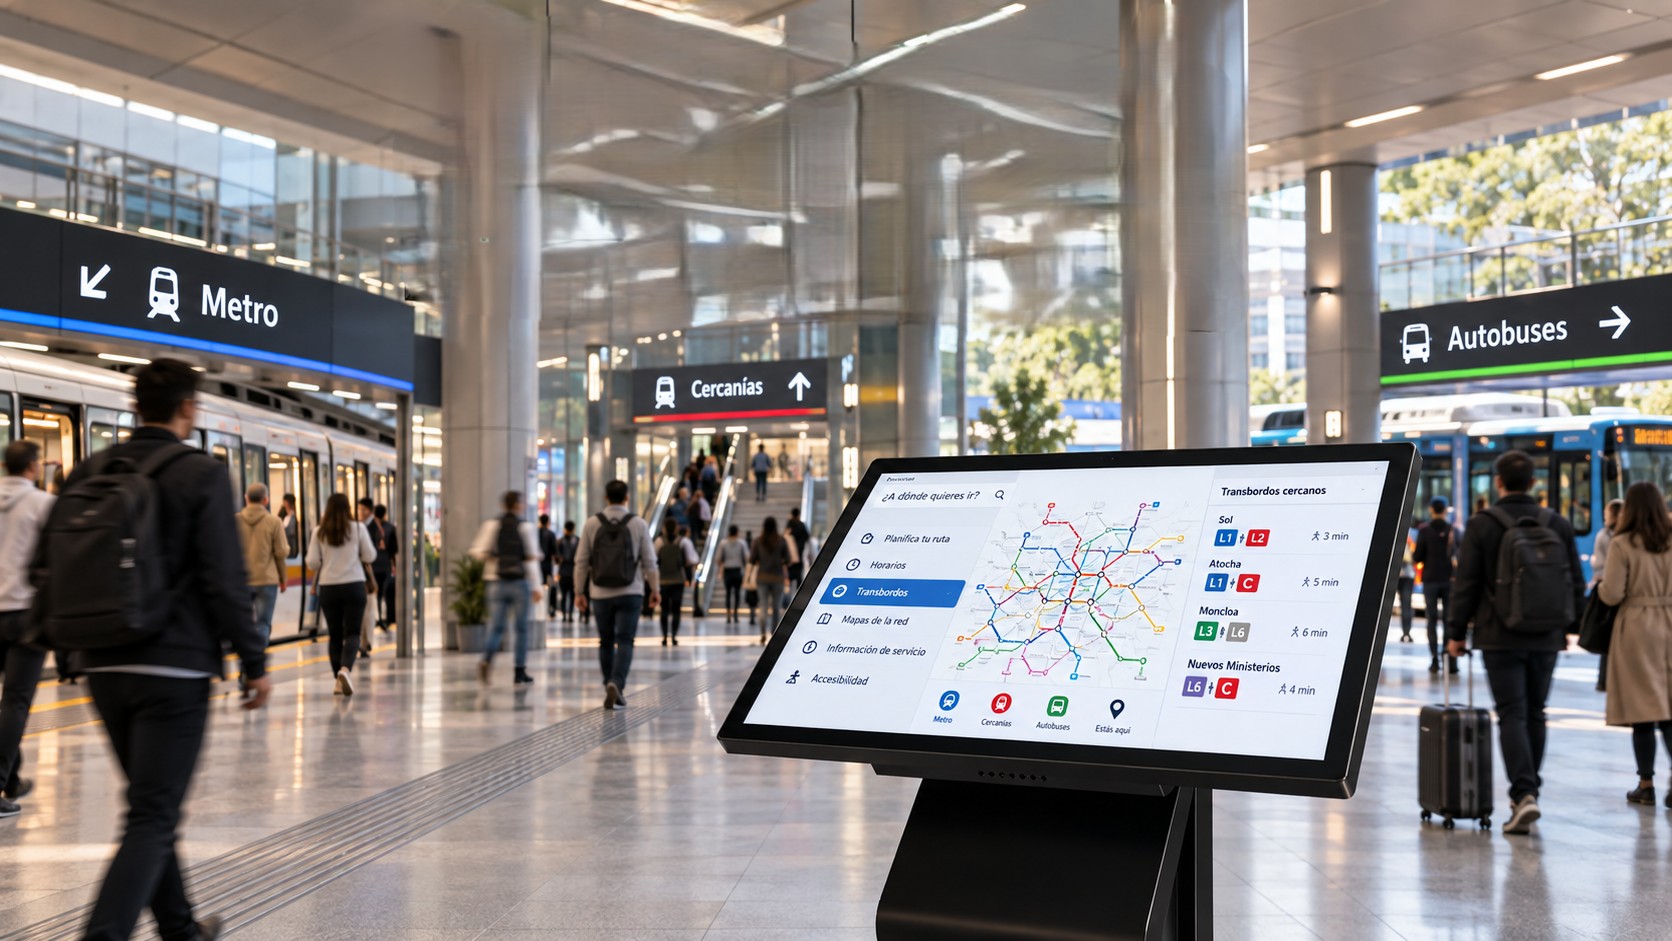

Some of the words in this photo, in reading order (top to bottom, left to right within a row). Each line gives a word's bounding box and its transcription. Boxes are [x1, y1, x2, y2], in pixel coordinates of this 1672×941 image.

[202, 284, 279, 328] Metro
[1447, 319, 1568, 352] Autobuses
[691, 377, 763, 398] Cercanías
[1221, 487, 1280, 496] Transbordos
[1283, 486, 1326, 495] cercanos
[881, 492, 895, 502] ¿A
[898, 491, 927, 501] dónde
[930, 491, 964, 502] quieres
[966, 491, 980, 500] ir?
[1218, 516, 1233, 524] Sol
[884, 534, 920, 544] Planifica
[922, 535, 931, 544] tu
[932, 535, 950, 544] ruta
[1219, 533, 1233, 543] L1
[1251, 533, 1265, 543] L2
[1323, 532, 1330, 540] 3
[1332, 532, 1349, 541] min
[870, 560, 906, 570] Horarios
[1208, 560, 1242, 568] Atocha
[1209, 578, 1223, 588] L1
[1243, 578, 1254, 589] C
[1313, 578, 1320, 586] 5
[1322, 578, 1339, 587] min
[856, 587, 909, 597] Transbordos
[1199, 606, 1239, 616] Moncloa
[842, 615, 869, 626] Mapas
[871, 616, 882, 625] de
[884, 616, 893, 625] la
[894, 617, 910, 626] red
[1199, 626, 1214, 637] L3
[1231, 627, 1244, 638] L6
[1302, 628, 1309, 637] 6
[1311, 628, 1328, 637] min
[826, 643, 878, 654] Información
[880, 646, 890, 655] de
[892, 647, 926, 657] servicio
[1187, 659, 1224, 670] Nuevos
[1226, 661, 1281, 673] Ministerios
[811, 673, 869, 686] Accesibilidad
[1187, 681, 1202, 692] L6
[1221, 682, 1233, 695] C
[1289, 685, 1296, 694] 4
[1298, 686, 1316, 695] min
[933, 716, 953, 724] Metro
[981, 719, 1012, 727] Cercanías
[1036, 722, 1071, 731] Autobuses
[1095, 725, 1114, 734] Estás
[1115, 727, 1131, 735] aquí
